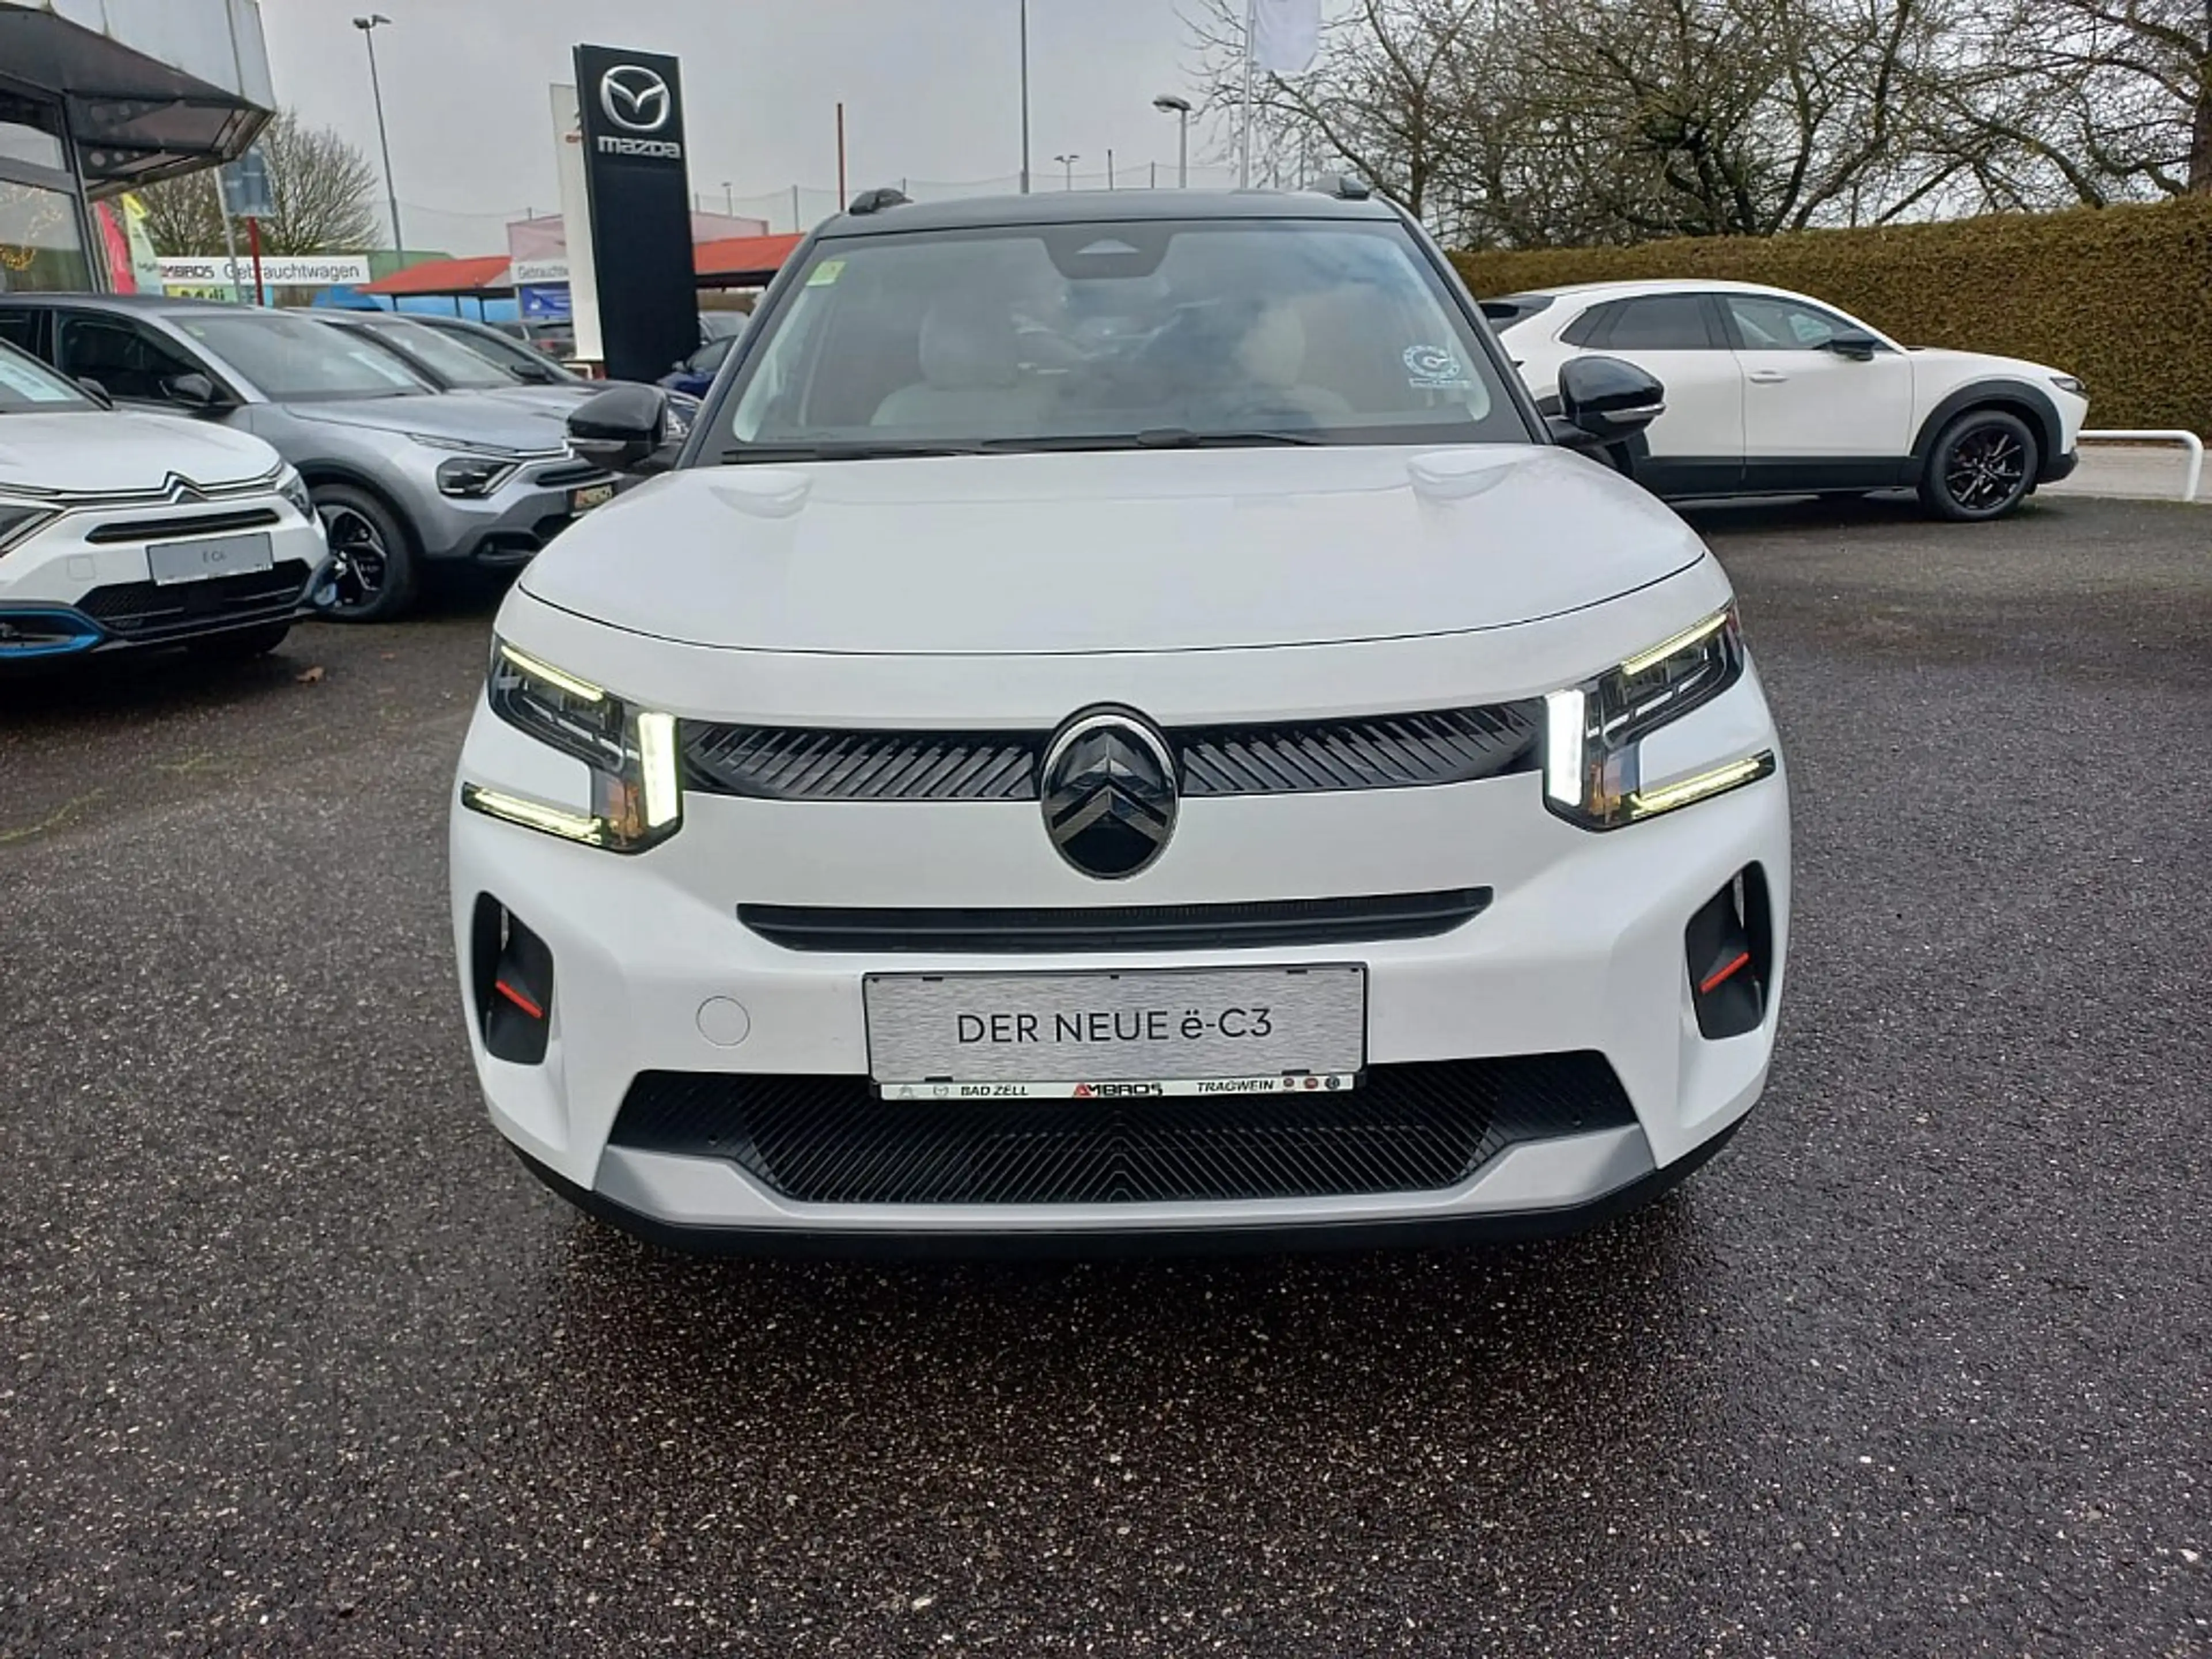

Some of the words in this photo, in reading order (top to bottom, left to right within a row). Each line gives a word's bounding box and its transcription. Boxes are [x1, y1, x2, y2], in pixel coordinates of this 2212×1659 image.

[224, 263, 360, 281] Gebauchtwagen
[958, 1013, 1039, 1043] DER
[1055, 1010, 1169, 1042] NEUE
[1180, 1008, 1272, 1039] ë-C3
[961, 1086, 990, 1096] BAD
[993, 1085, 1029, 1096] ZELL
[1073, 1083, 1163, 1098] AMBROS
[1196, 1080, 1274, 1093] TRAGWEIN
